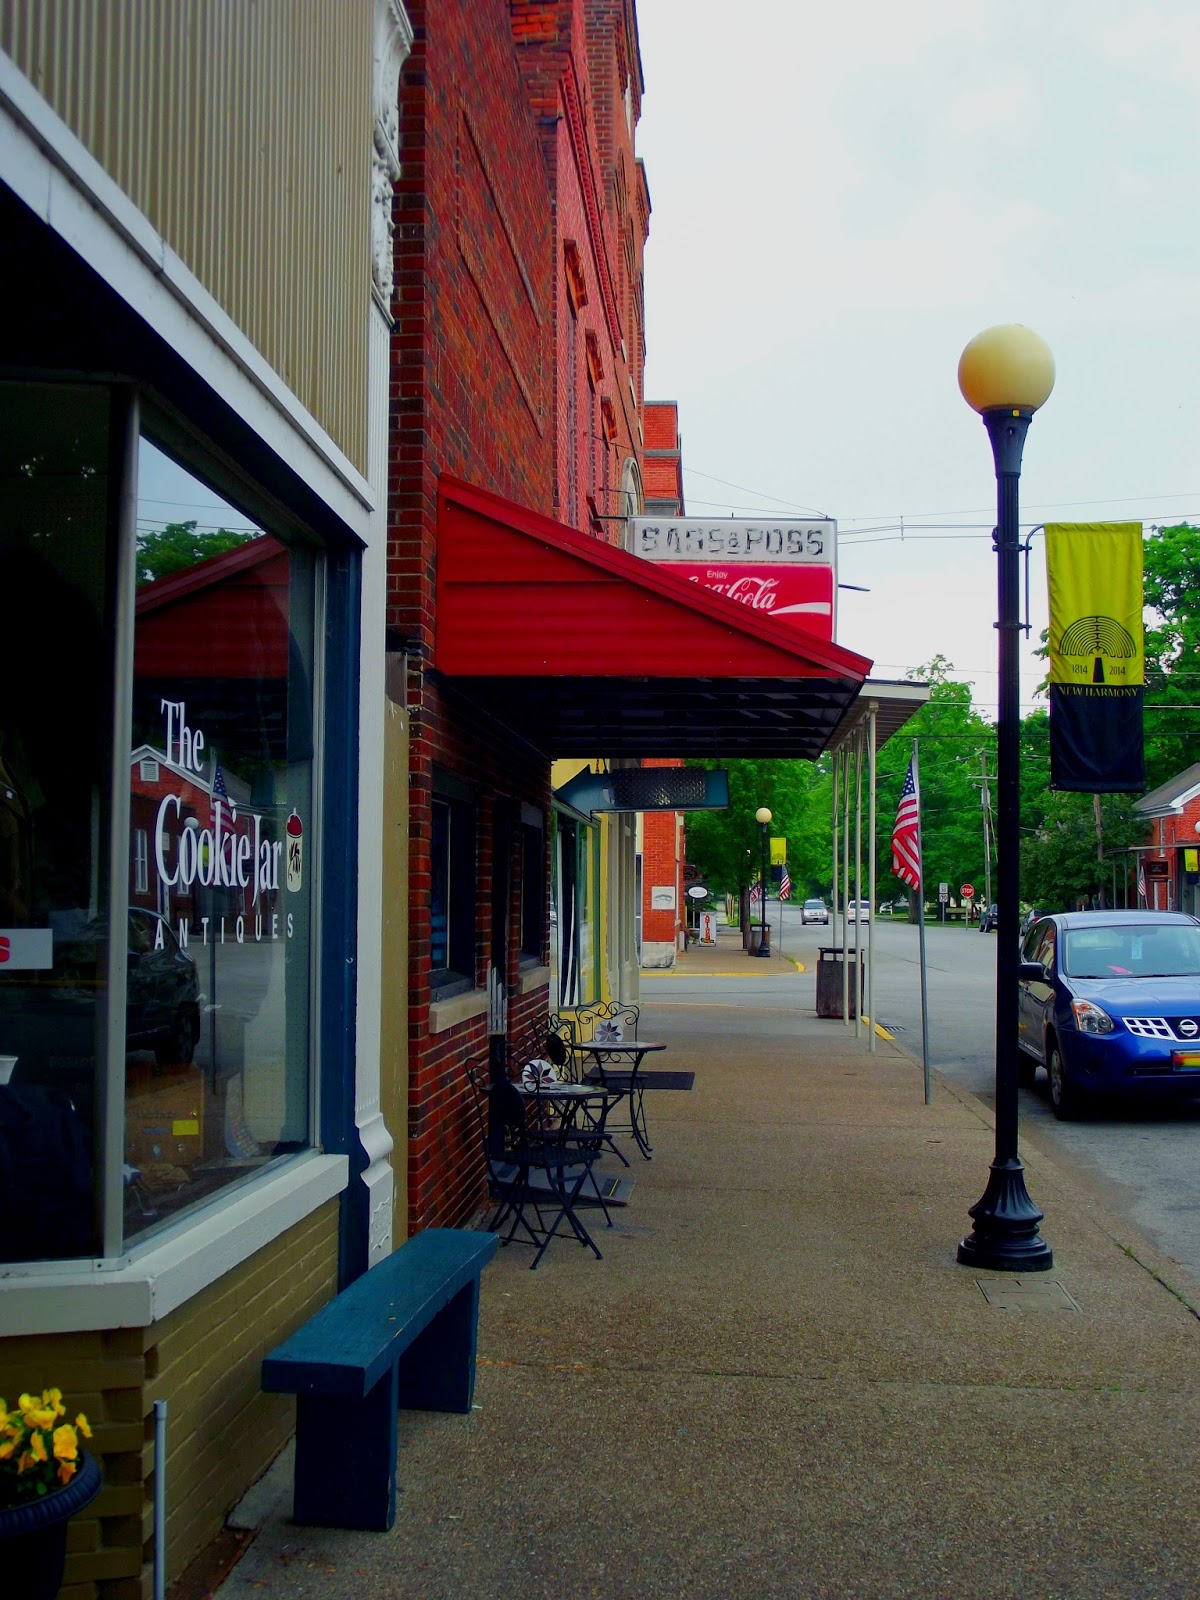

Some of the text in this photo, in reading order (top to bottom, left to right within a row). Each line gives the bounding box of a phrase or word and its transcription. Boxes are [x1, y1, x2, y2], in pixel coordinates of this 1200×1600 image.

[706, 570, 728, 580] Enjoy
[1072, 665, 1088, 675] 1814
[1109, 666, 1126, 676] 2014
[1059, 686, 1138, 698] NEW HARMONY
[161, 699, 204, 772] The
[154, 913, 294, 950] ANTIQUES
